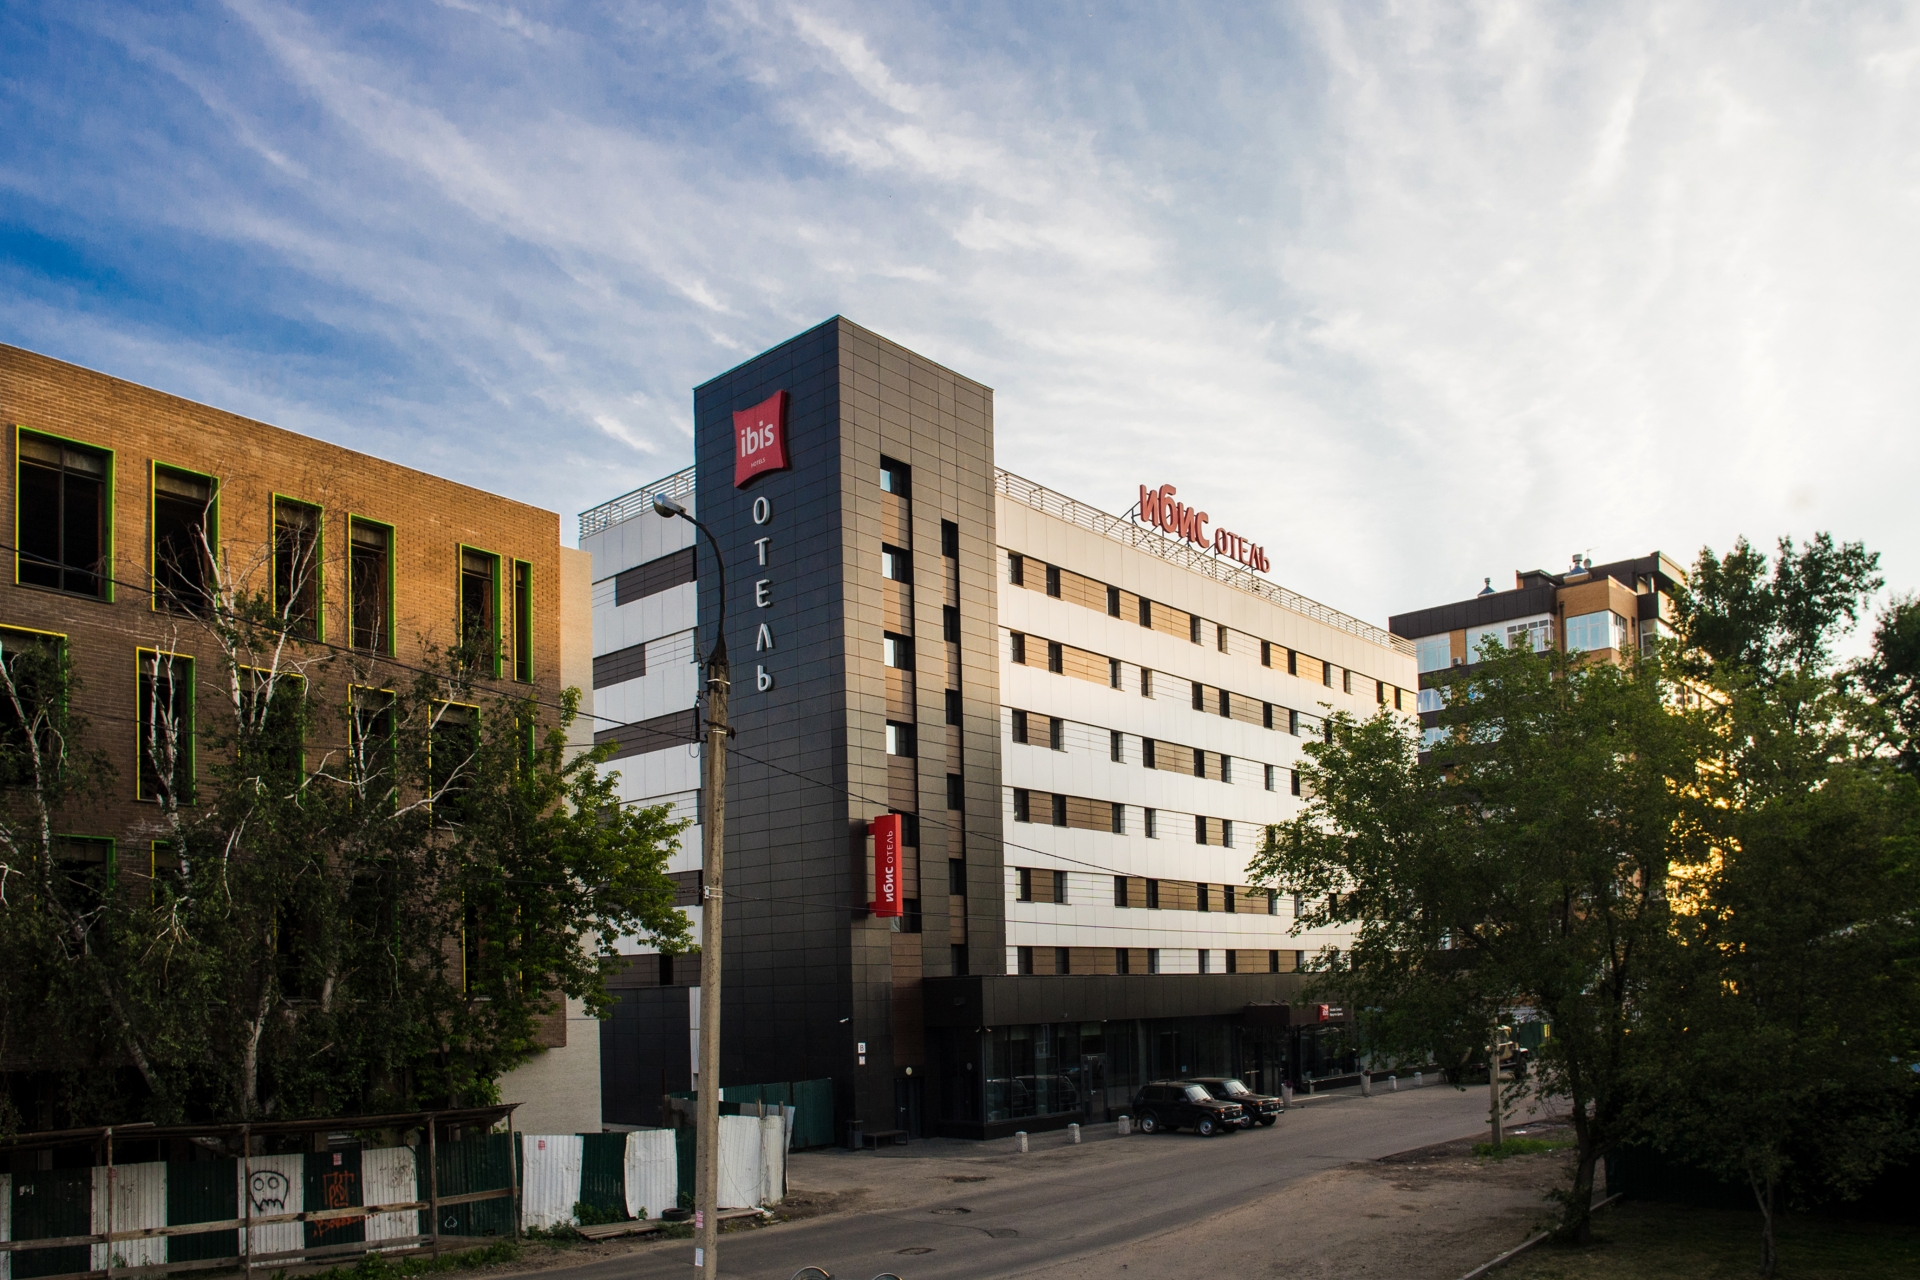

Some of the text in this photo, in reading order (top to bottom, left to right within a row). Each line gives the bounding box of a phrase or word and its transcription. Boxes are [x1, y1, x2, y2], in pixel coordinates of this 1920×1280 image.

[741, 421, 774, 457] ibis
[1215, 528, 1270, 573] ОТЕЛЬ
[753, 496, 772, 692] ОТЕЛЬ
[883, 866, 894, 902] ибис
